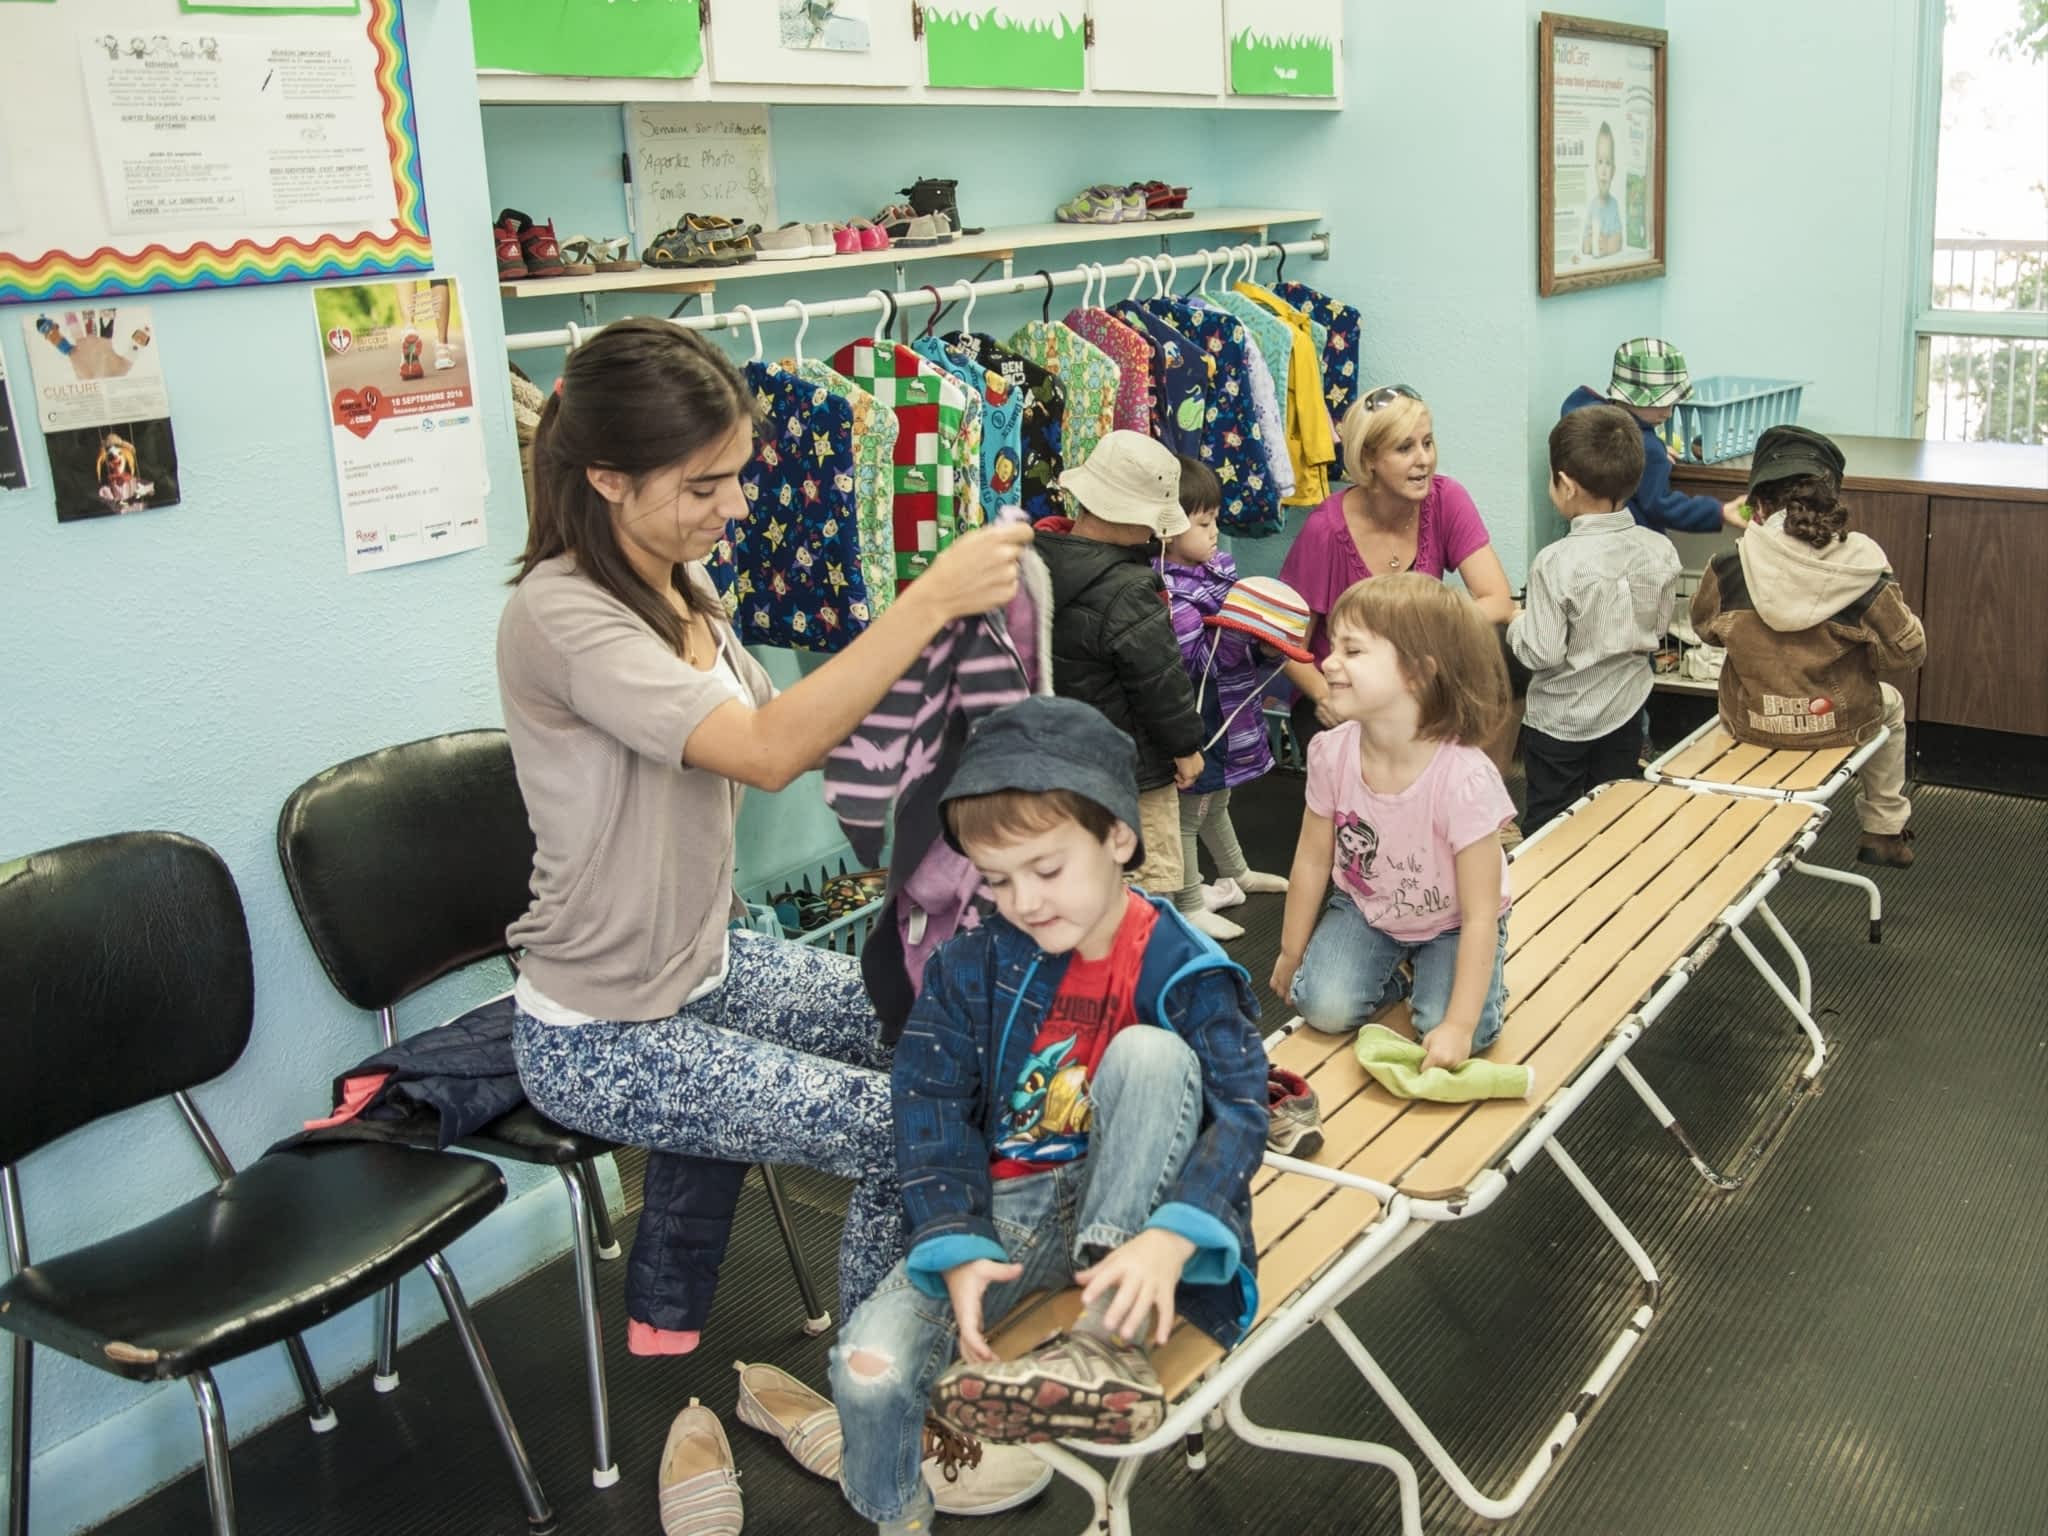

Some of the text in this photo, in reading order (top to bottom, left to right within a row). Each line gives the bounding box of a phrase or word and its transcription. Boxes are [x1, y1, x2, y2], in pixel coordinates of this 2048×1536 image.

[702, 149, 735, 168] Photo
[1001, 360, 1024, 376] BEN
[43, 382, 99, 399] CULTURE
[402, 392, 445, 405] SEPTEMBRE
[1763, 694, 1810, 716] SPACE
[1747, 708, 1836, 735] TRAVELLERS
[1400, 877, 1420, 890] est
[1391, 885, 1450, 919] Belle
